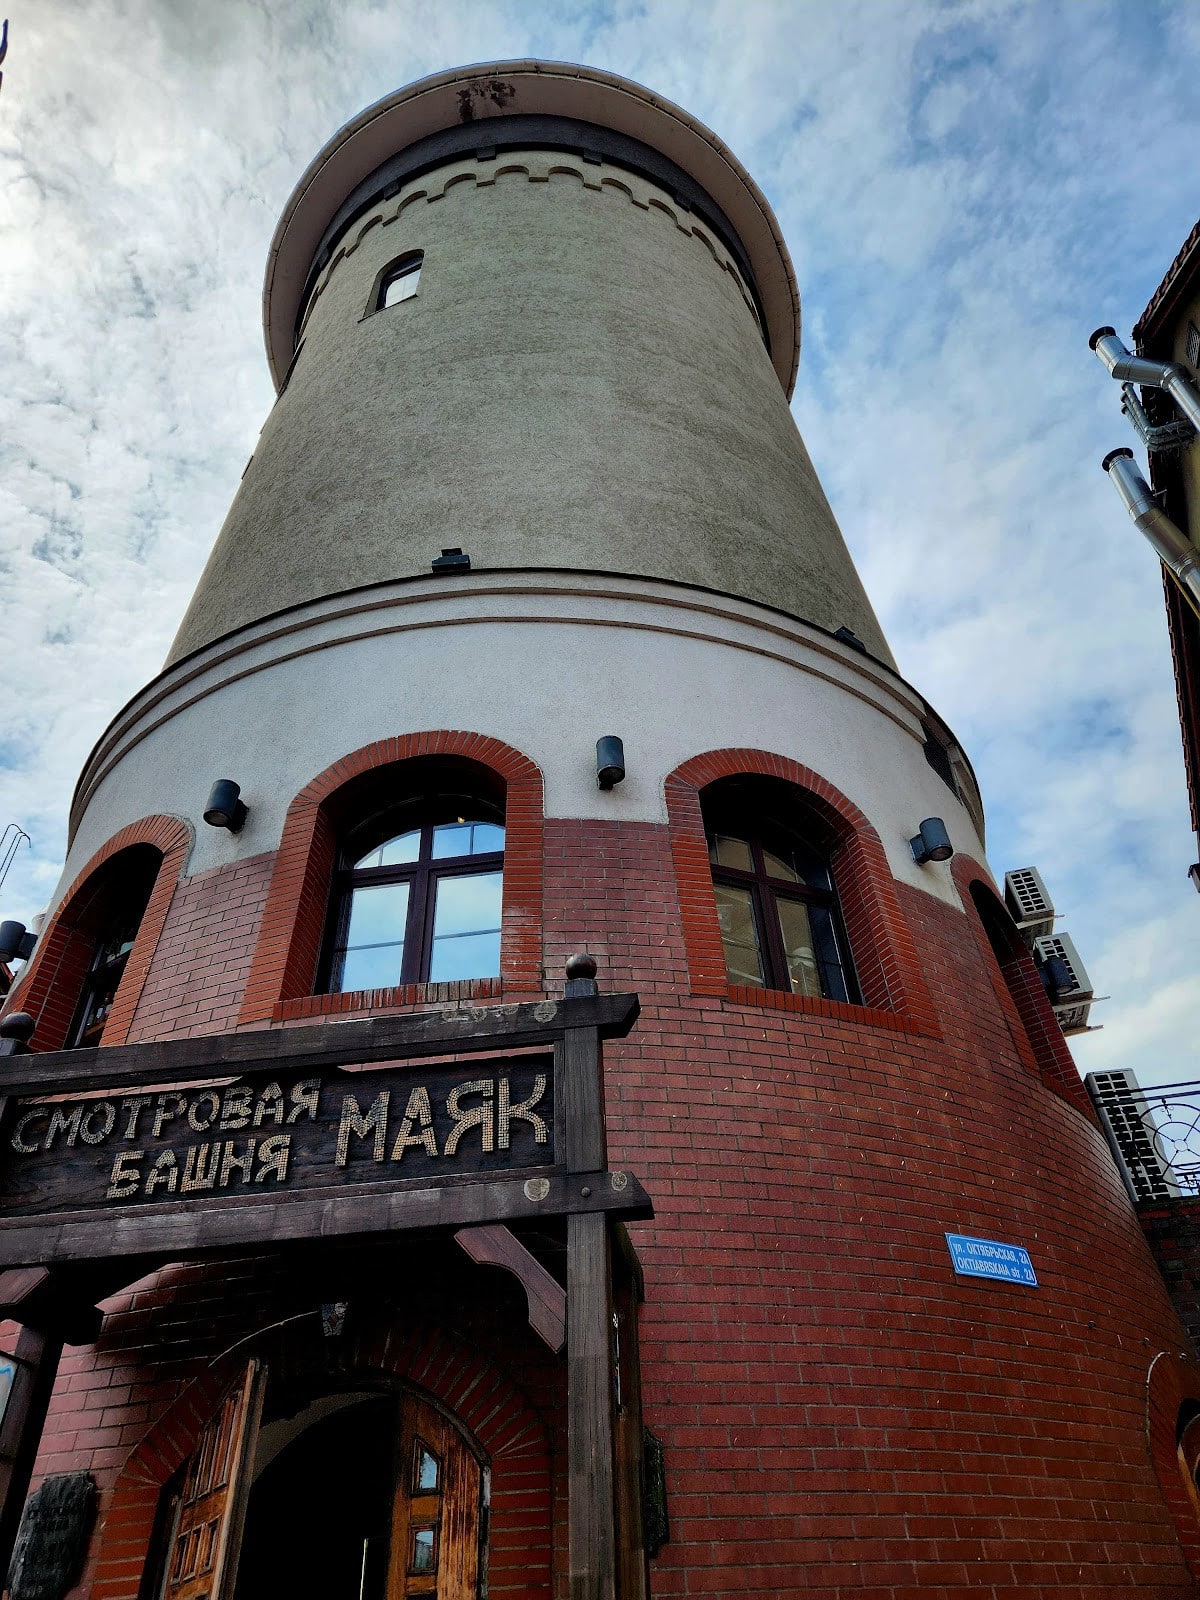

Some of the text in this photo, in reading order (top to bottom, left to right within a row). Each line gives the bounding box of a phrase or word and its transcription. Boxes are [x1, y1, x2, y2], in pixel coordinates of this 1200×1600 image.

[11, 1078, 322, 1153] СМОТРОВАЯ
[335, 1074, 548, 1167] МАЯК
[106, 1134, 291, 1199] БАШНЯ
[966, 1242, 1020, 1264] ОКТЯБРЬСКАЯ,
